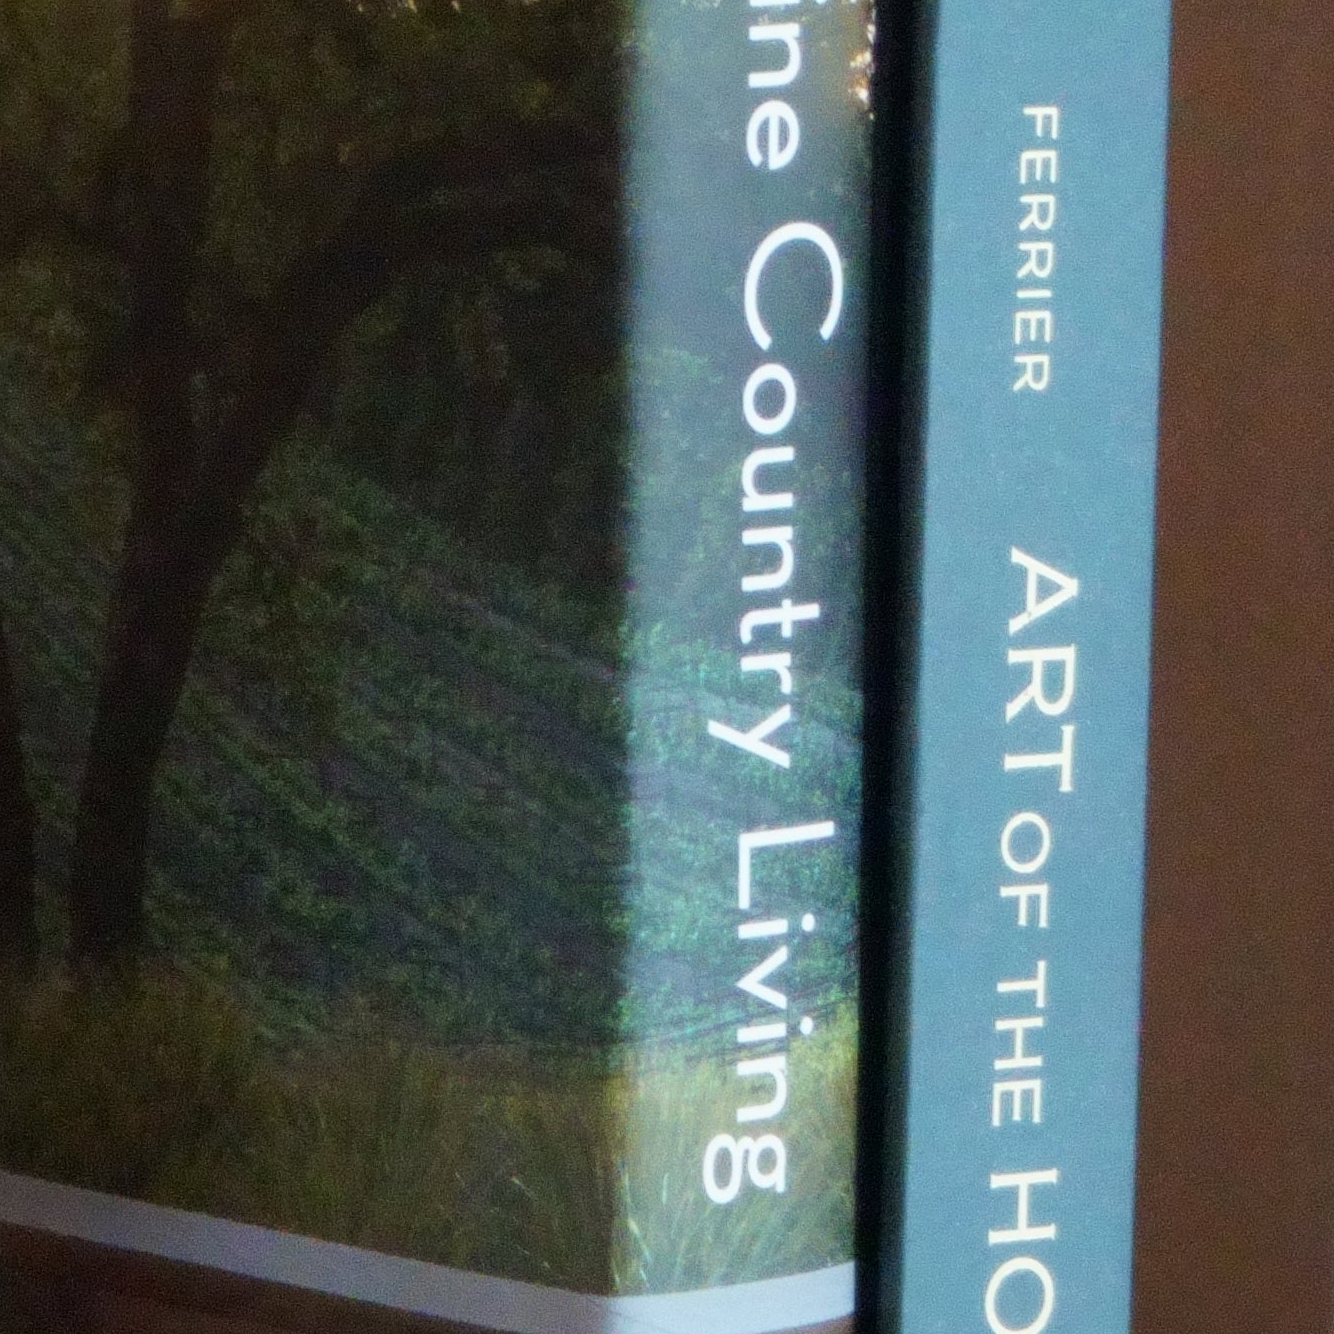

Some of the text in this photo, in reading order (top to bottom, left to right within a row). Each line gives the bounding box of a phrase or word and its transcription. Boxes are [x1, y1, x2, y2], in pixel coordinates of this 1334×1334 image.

[1013, 106, 1059, 391] FERRIER
[706, 221, 844, 769] Country
[1003, 547, 1079, 793] ART
[999, 811, 1051, 928] OF
[702, 821, 835, 1205] Living
[992, 960, 1047, 1127] THE
